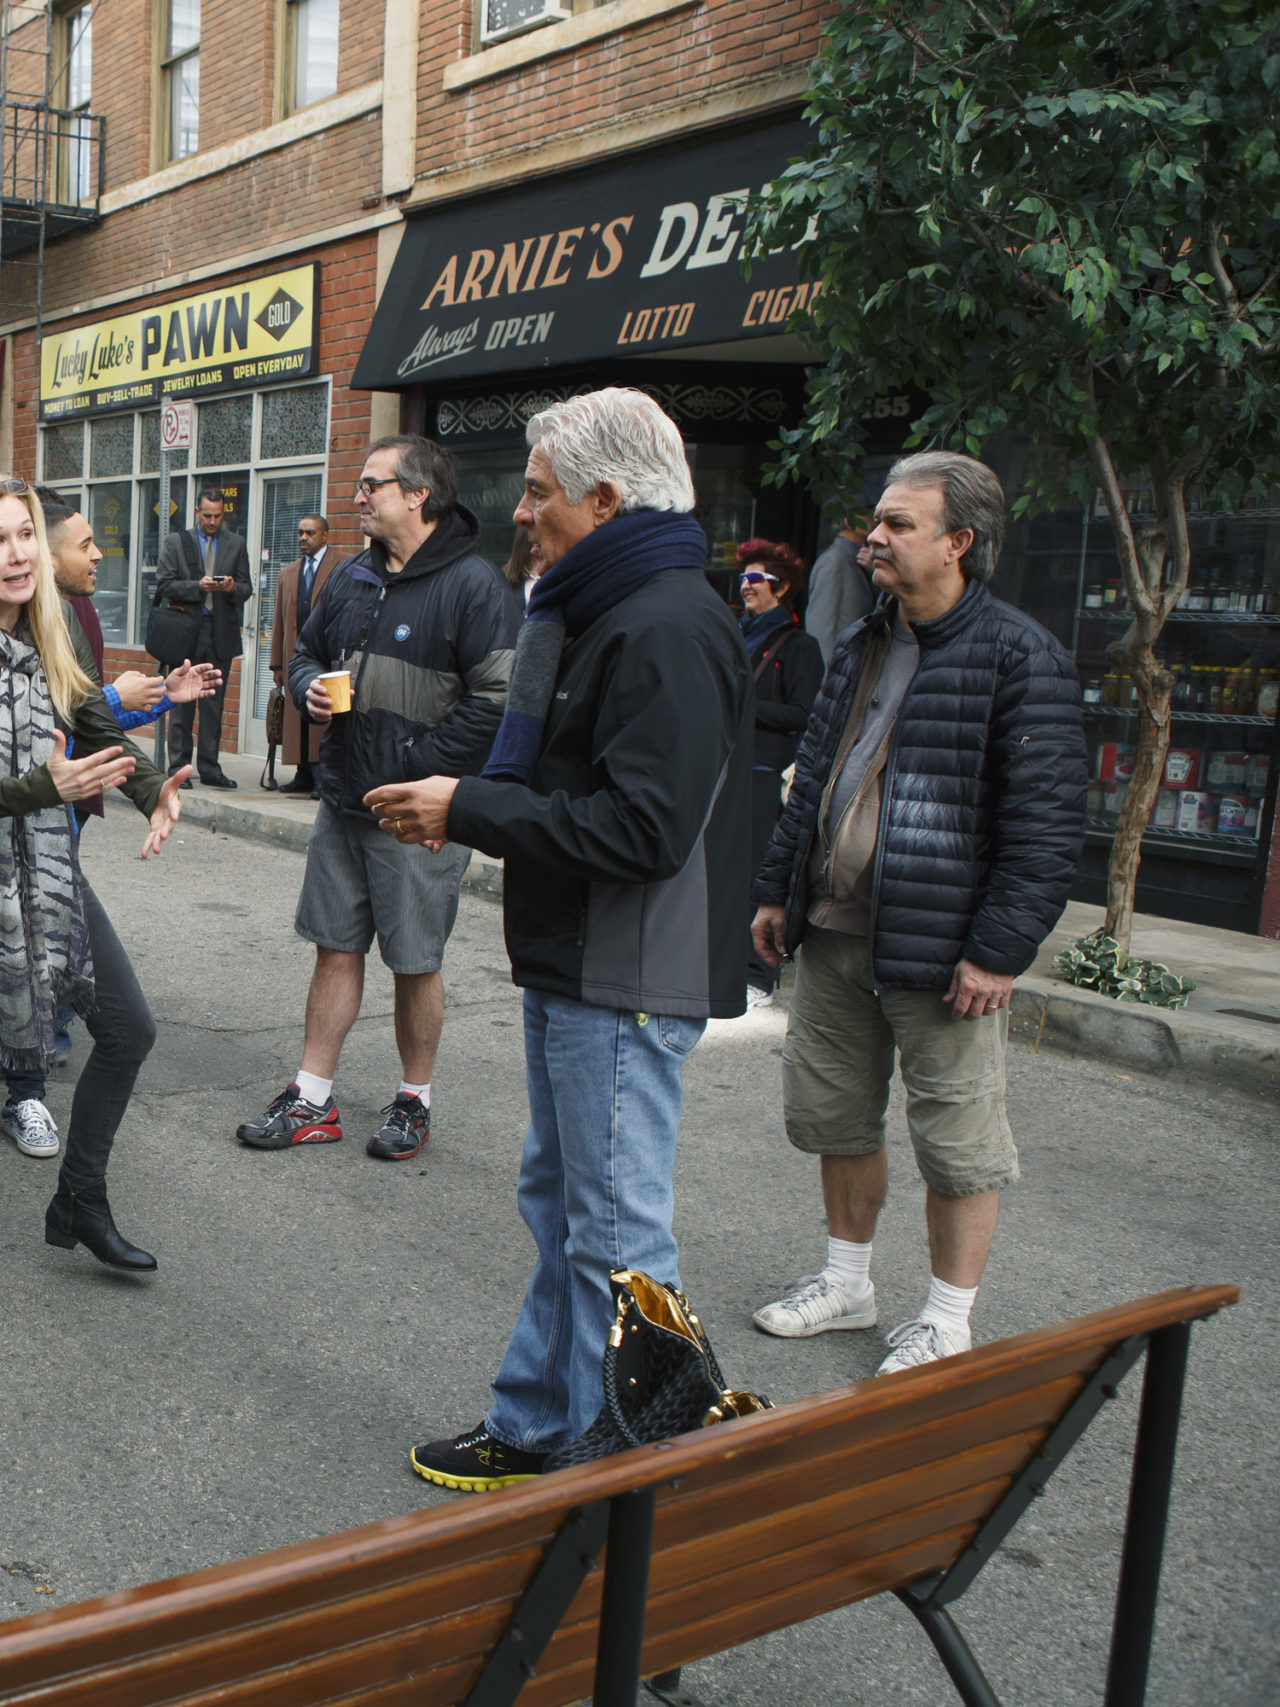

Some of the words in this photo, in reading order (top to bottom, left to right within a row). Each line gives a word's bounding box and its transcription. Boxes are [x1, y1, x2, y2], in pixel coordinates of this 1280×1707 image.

[419, 215, 634, 311] ARNIE'S
[51, 339, 88, 389] Lucky
[88, 331, 134, 381] Luke's
[141, 291, 250, 371] PAWN
[268, 301, 291, 328] GOLD
[397, 317, 480, 378] Always
[484, 311, 555, 350] OPEN
[617, 302, 696, 344] LOTTO
[44, 402, 65, 414] MONEY
[66, 399, 73, 410] TO
[73, 396, 90, 409] LOAN
[97, 383, 153, 405] BUY-SELL-TRADE
[162, 375, 195, 392] JEWELRY
[196, 370, 222, 386] LOANS
[233, 364, 256, 379] OPEN
[257, 353, 304, 374] EVERYDAY
